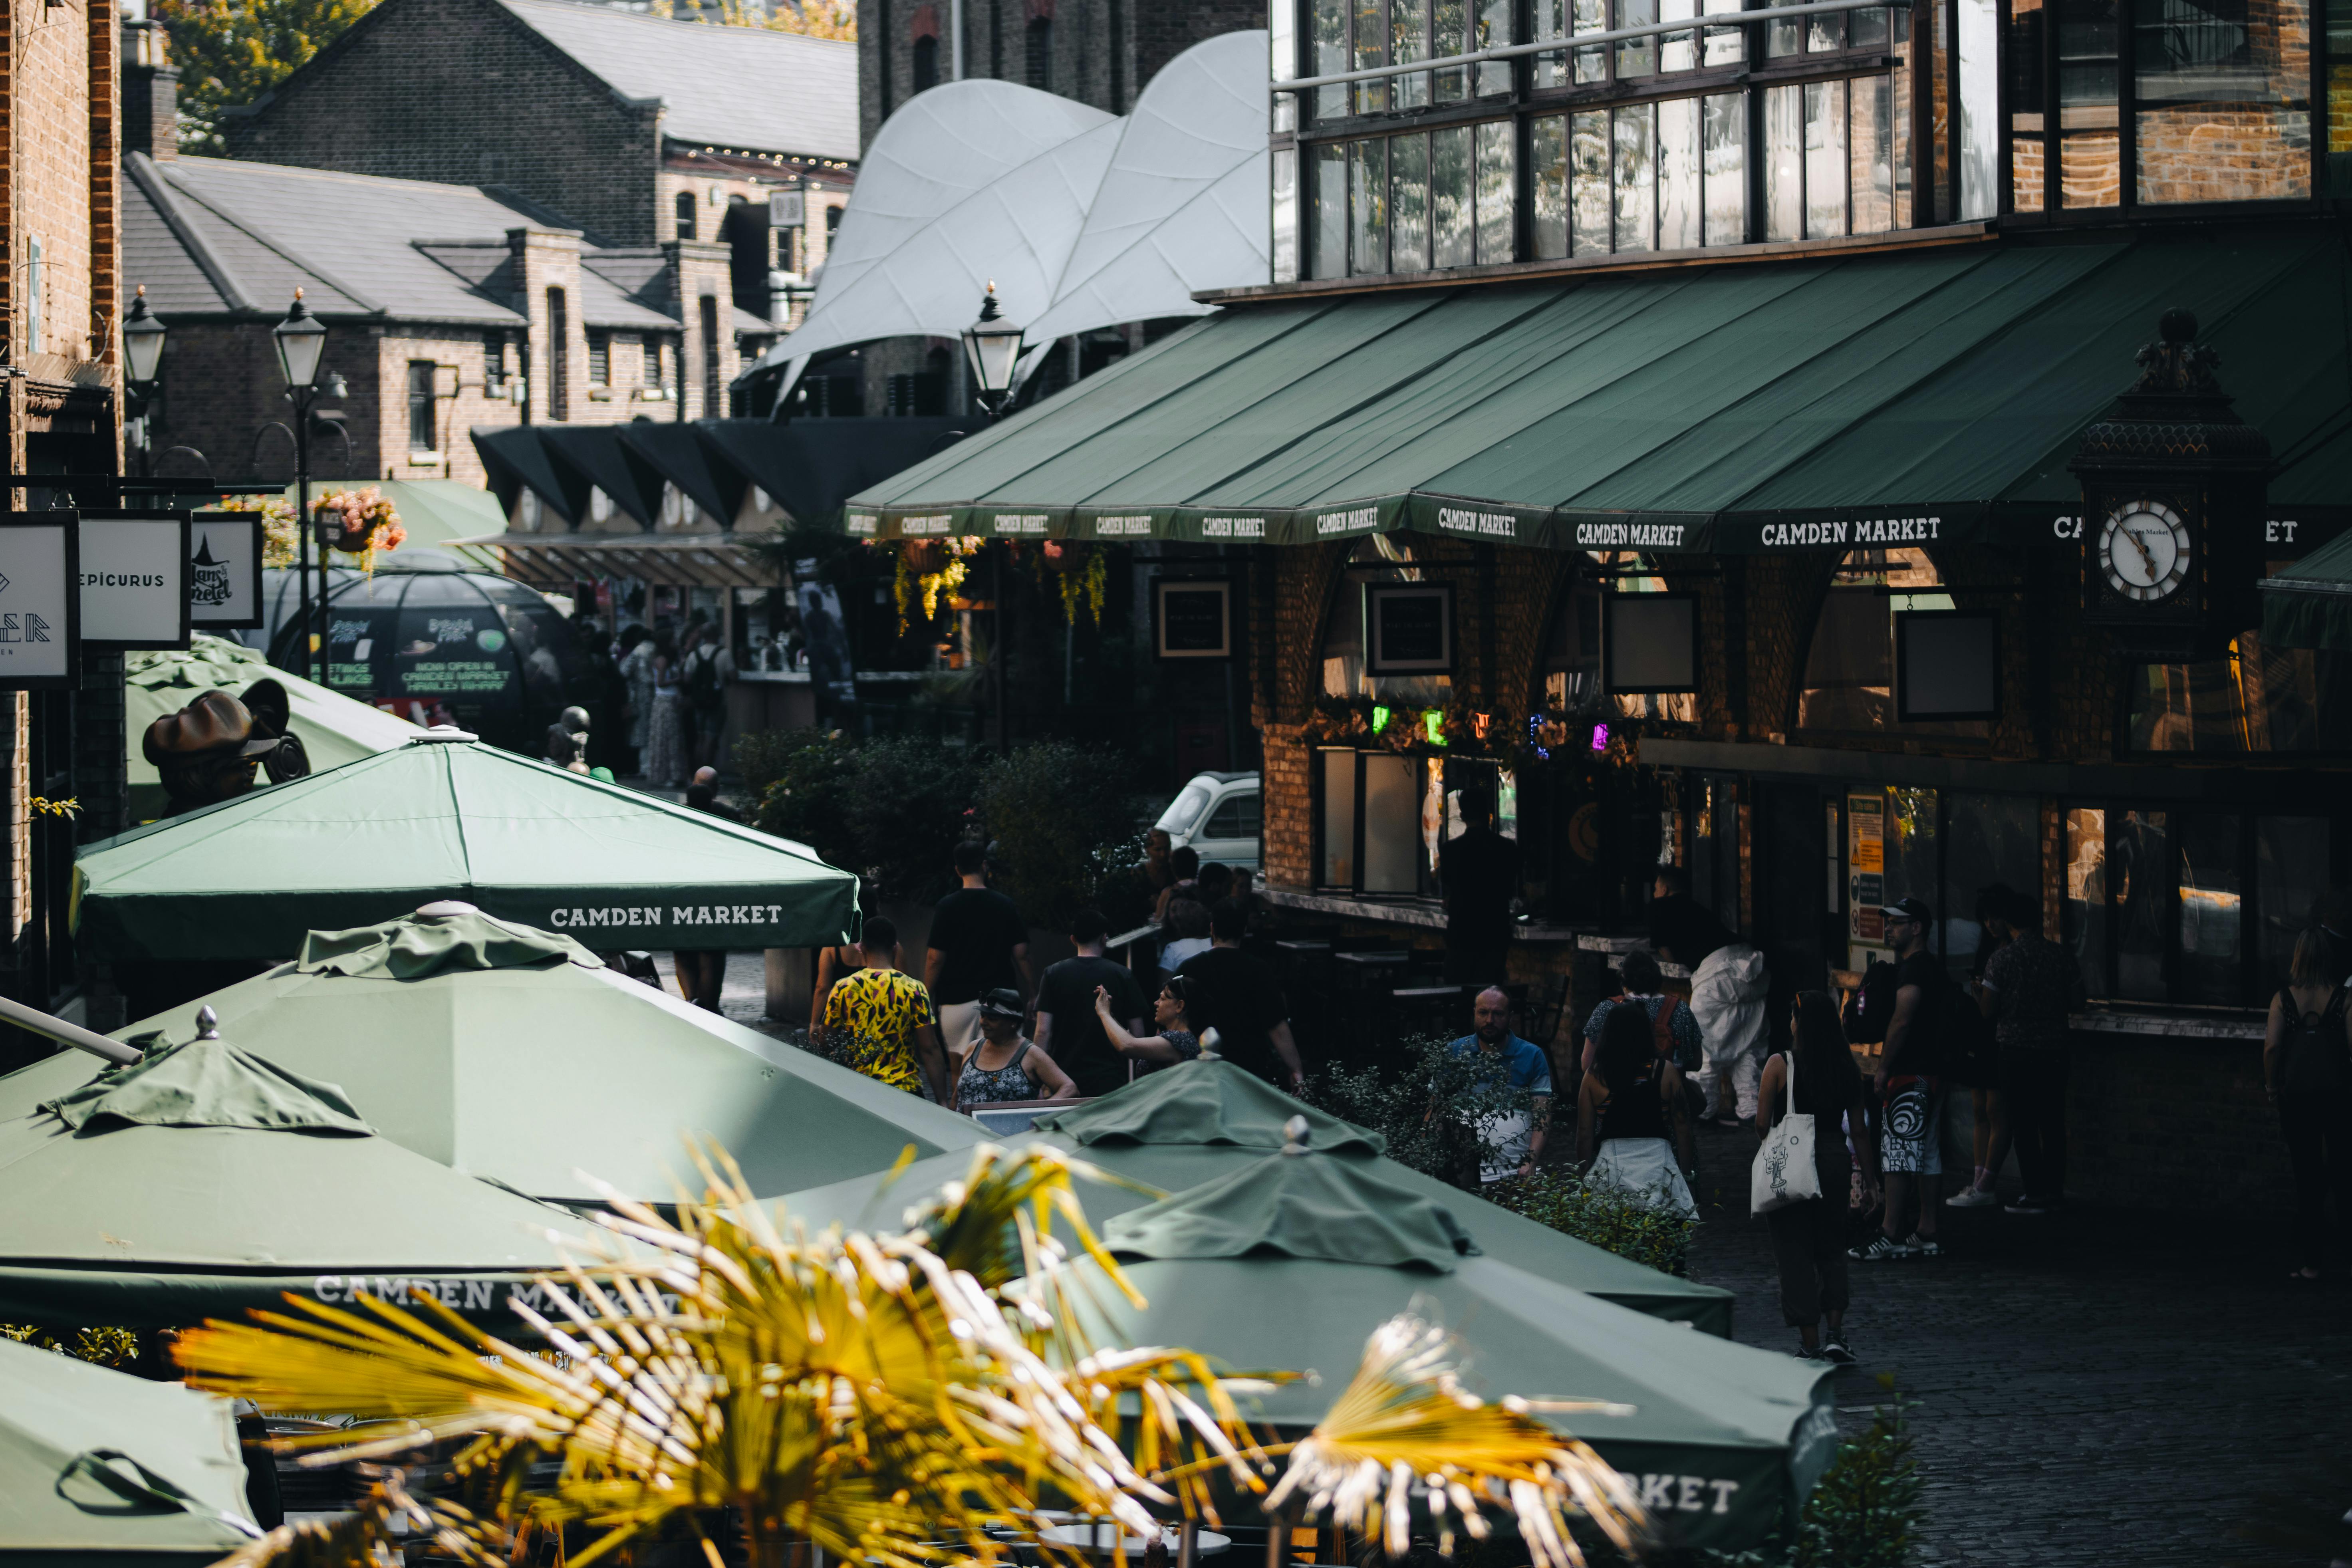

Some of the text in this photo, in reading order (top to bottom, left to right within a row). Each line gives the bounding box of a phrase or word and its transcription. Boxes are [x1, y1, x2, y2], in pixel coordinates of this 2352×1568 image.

[1096, 515, 1152, 534] CAMDEN MARKET
[1202, 518, 1265, 536] CAMDEN MARKET
[1317, 506, 1379, 534] CAMDEN MARKET
[1438, 507, 1516, 537] CAMDEN MARKET
[1762, 517, 1941, 546] CAMDEN MARKET
[1577, 523, 1684, 546] CAMDEN MARKET
[551, 905, 782, 927] CAMDEN MARKET
[314, 1274, 494, 1310] CAMDEN
